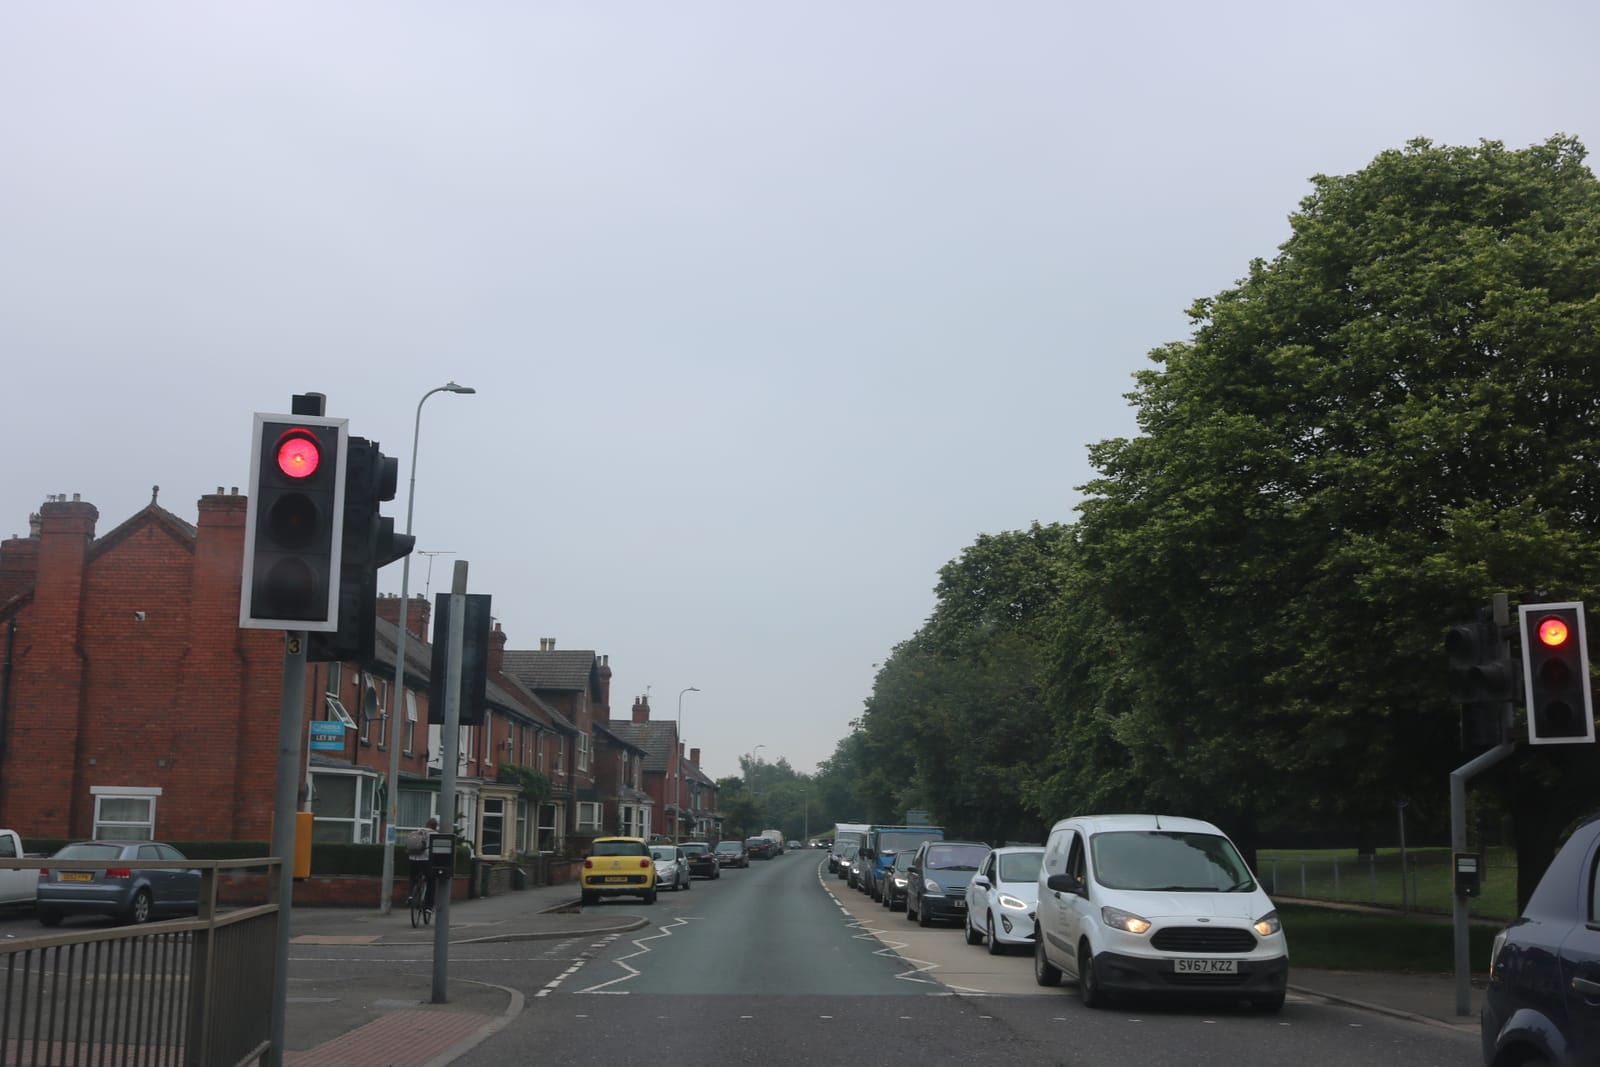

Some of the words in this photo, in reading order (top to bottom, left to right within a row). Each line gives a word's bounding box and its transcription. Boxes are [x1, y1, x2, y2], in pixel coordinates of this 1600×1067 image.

[289, 639, 300, 654] 3
[1178, 960, 1208, 971] SV67
[1210, 960, 1233, 972] KZZ
